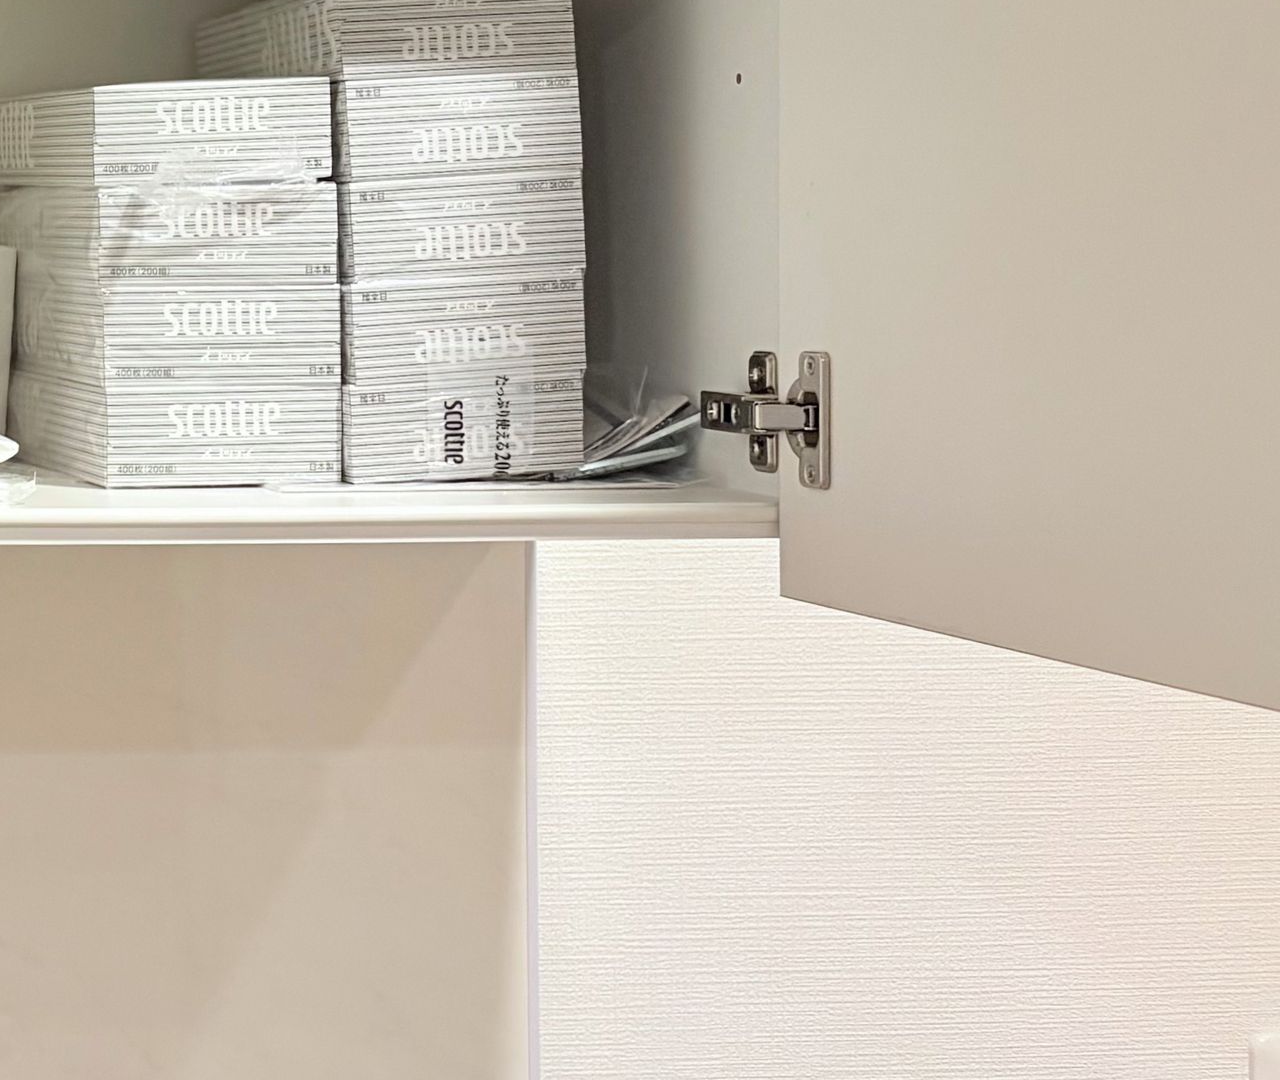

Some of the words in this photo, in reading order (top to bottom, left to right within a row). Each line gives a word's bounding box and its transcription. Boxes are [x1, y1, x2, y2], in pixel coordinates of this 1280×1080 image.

[402, 23, 513, 60] scottie
[157, 96, 270, 134] scottie
[411, 125, 523, 163] scottie
[415, 222, 527, 260] scottie
[306, 265, 331, 274] 日本製
[164, 300, 277, 336] scottie
[415, 325, 525, 363] scottie
[309, 366, 334, 375] 日本製
[168, 400, 280, 437] scottie
[443, 400, 466, 465] scottie
